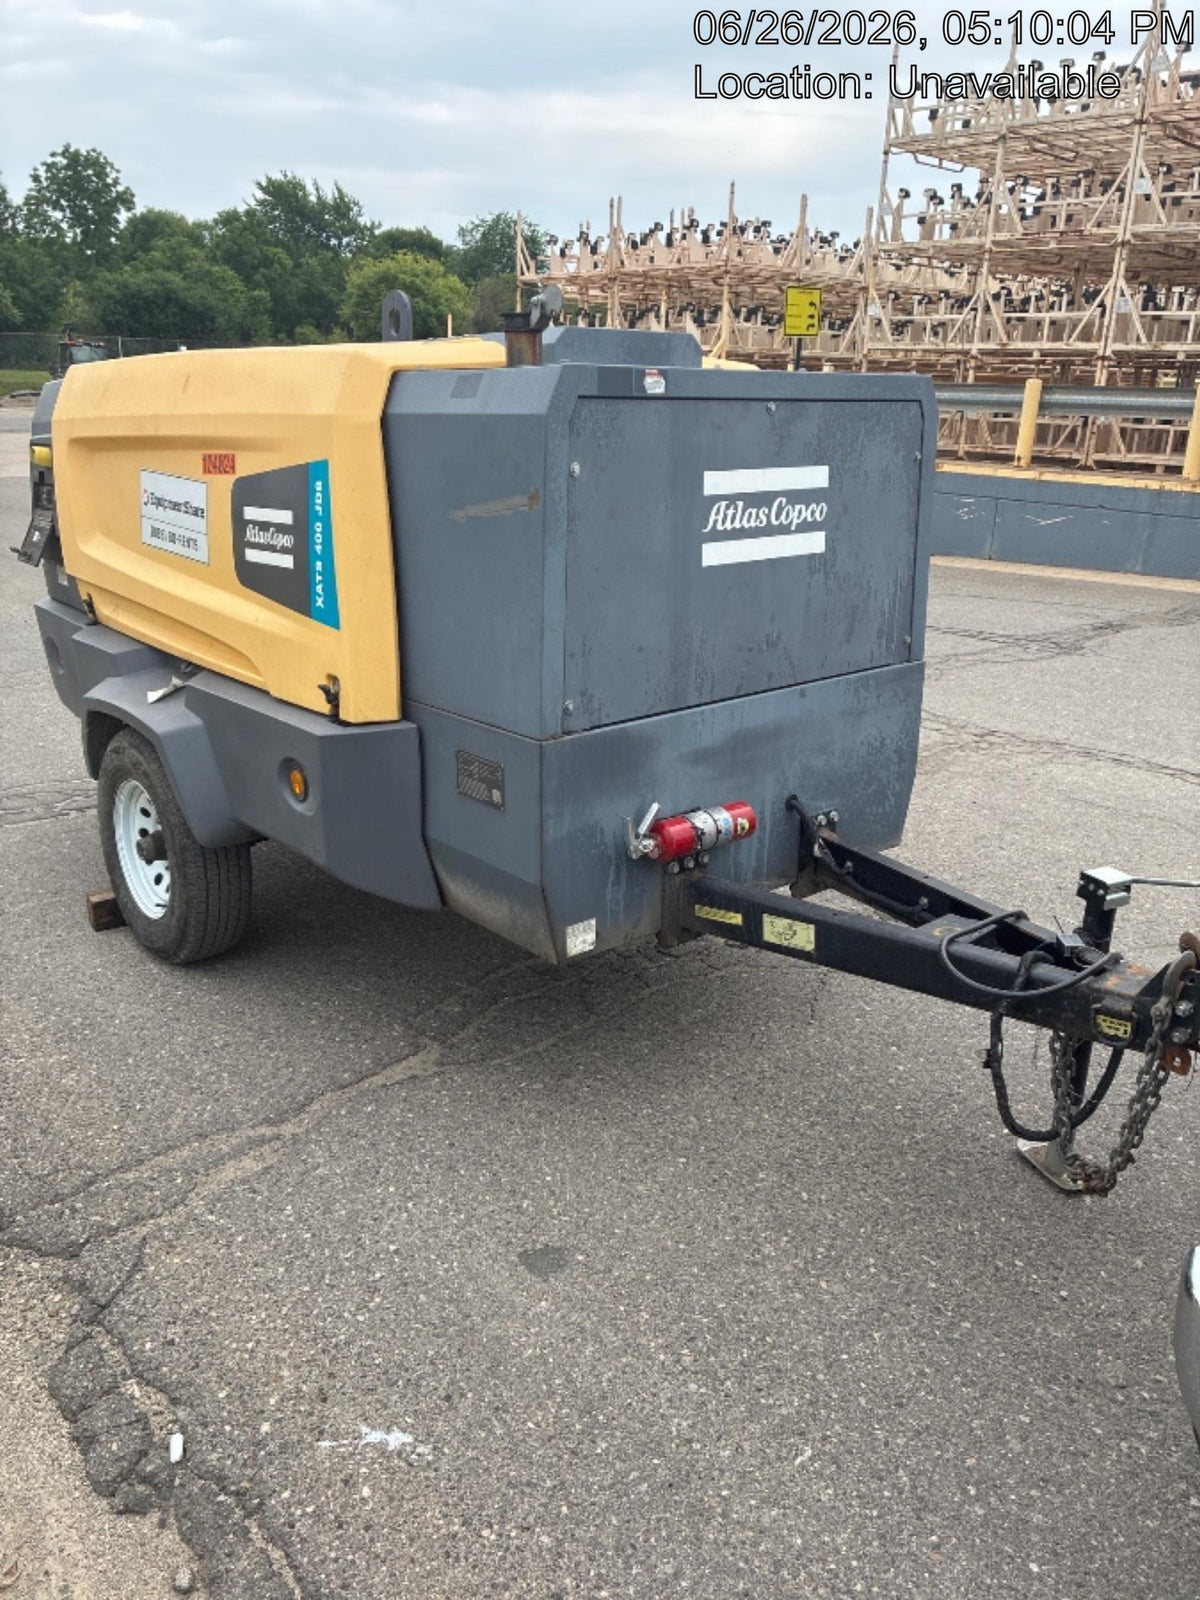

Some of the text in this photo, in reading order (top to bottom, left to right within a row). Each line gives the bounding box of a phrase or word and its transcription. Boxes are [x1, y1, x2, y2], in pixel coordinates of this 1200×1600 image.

[702, 496, 827, 533] Atlas Copco
[244, 523, 294, 550] Atlas Copco
[313, 521, 323, 556] 400
[314, 561, 325, 609] XATS
